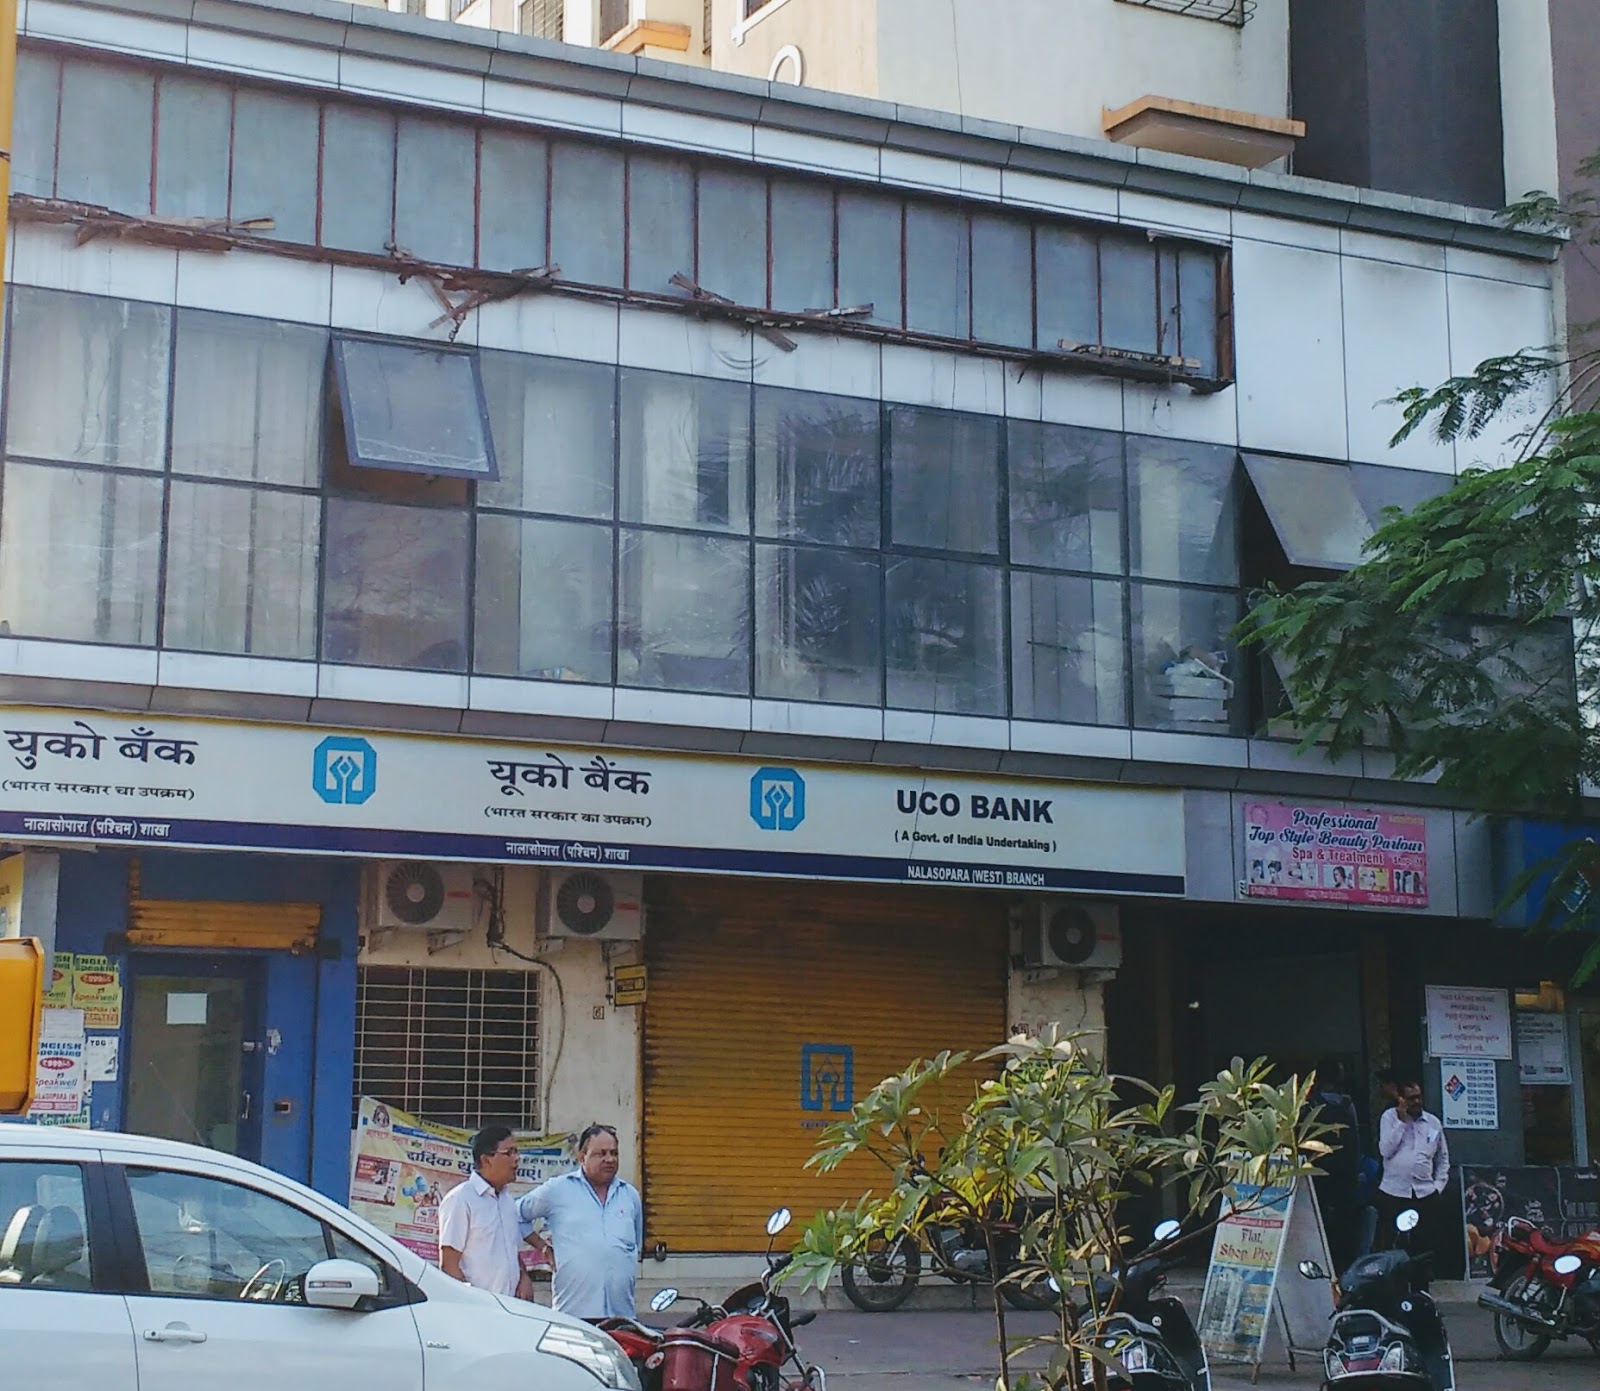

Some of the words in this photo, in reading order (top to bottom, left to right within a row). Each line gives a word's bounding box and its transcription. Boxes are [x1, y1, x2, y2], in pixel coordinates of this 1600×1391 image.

[3, 720, 108, 770] युको
[113, 726, 199, 766] बँक
[486, 752, 574, 796] यूको
[579, 755, 652, 795] बैंक
[2, 779, 51, 792] (भारत
[54, 782, 111, 796] सरकार
[115, 785, 135, 797] चा
[138, 787, 195, 800] उपक्रम)
[484, 805, 527, 818] (भारत
[529, 809, 578, 822] सरकार
[581, 812, 600, 824] का
[603, 814, 652, 828] उपक्रम)
[896, 789, 961, 818] UCO
[970, 794, 1054, 824] BANK
[23, 815, 89, 834] नालासोपारा
[140, 822, 170, 837] शाखा
[1292, 808, 1378, 830] Professional
[912, 831, 940, 843] Govt.
[943, 833, 954, 844] of
[957, 834, 983, 846] India
[986, 836, 1050, 852] Undertaking
[1249, 825, 1275, 844] Top
[1279, 828, 1315, 846] Style
[1318, 830, 1368, 850] Beauty
[1372, 834, 1423, 852] Parlour
[505, 840, 560, 857] नालासोपारा
[604, 848, 630, 861] शाखा
[1292, 846, 1313, 861] Spa
[1316, 848, 1325, 860] &
[1328, 849, 1383, 864] Treatment
[907, 864, 970, 882] NALASOPARA
[971, 869, 1004, 885] (WEST)
[1006, 871, 1045, 886] BRANCH
